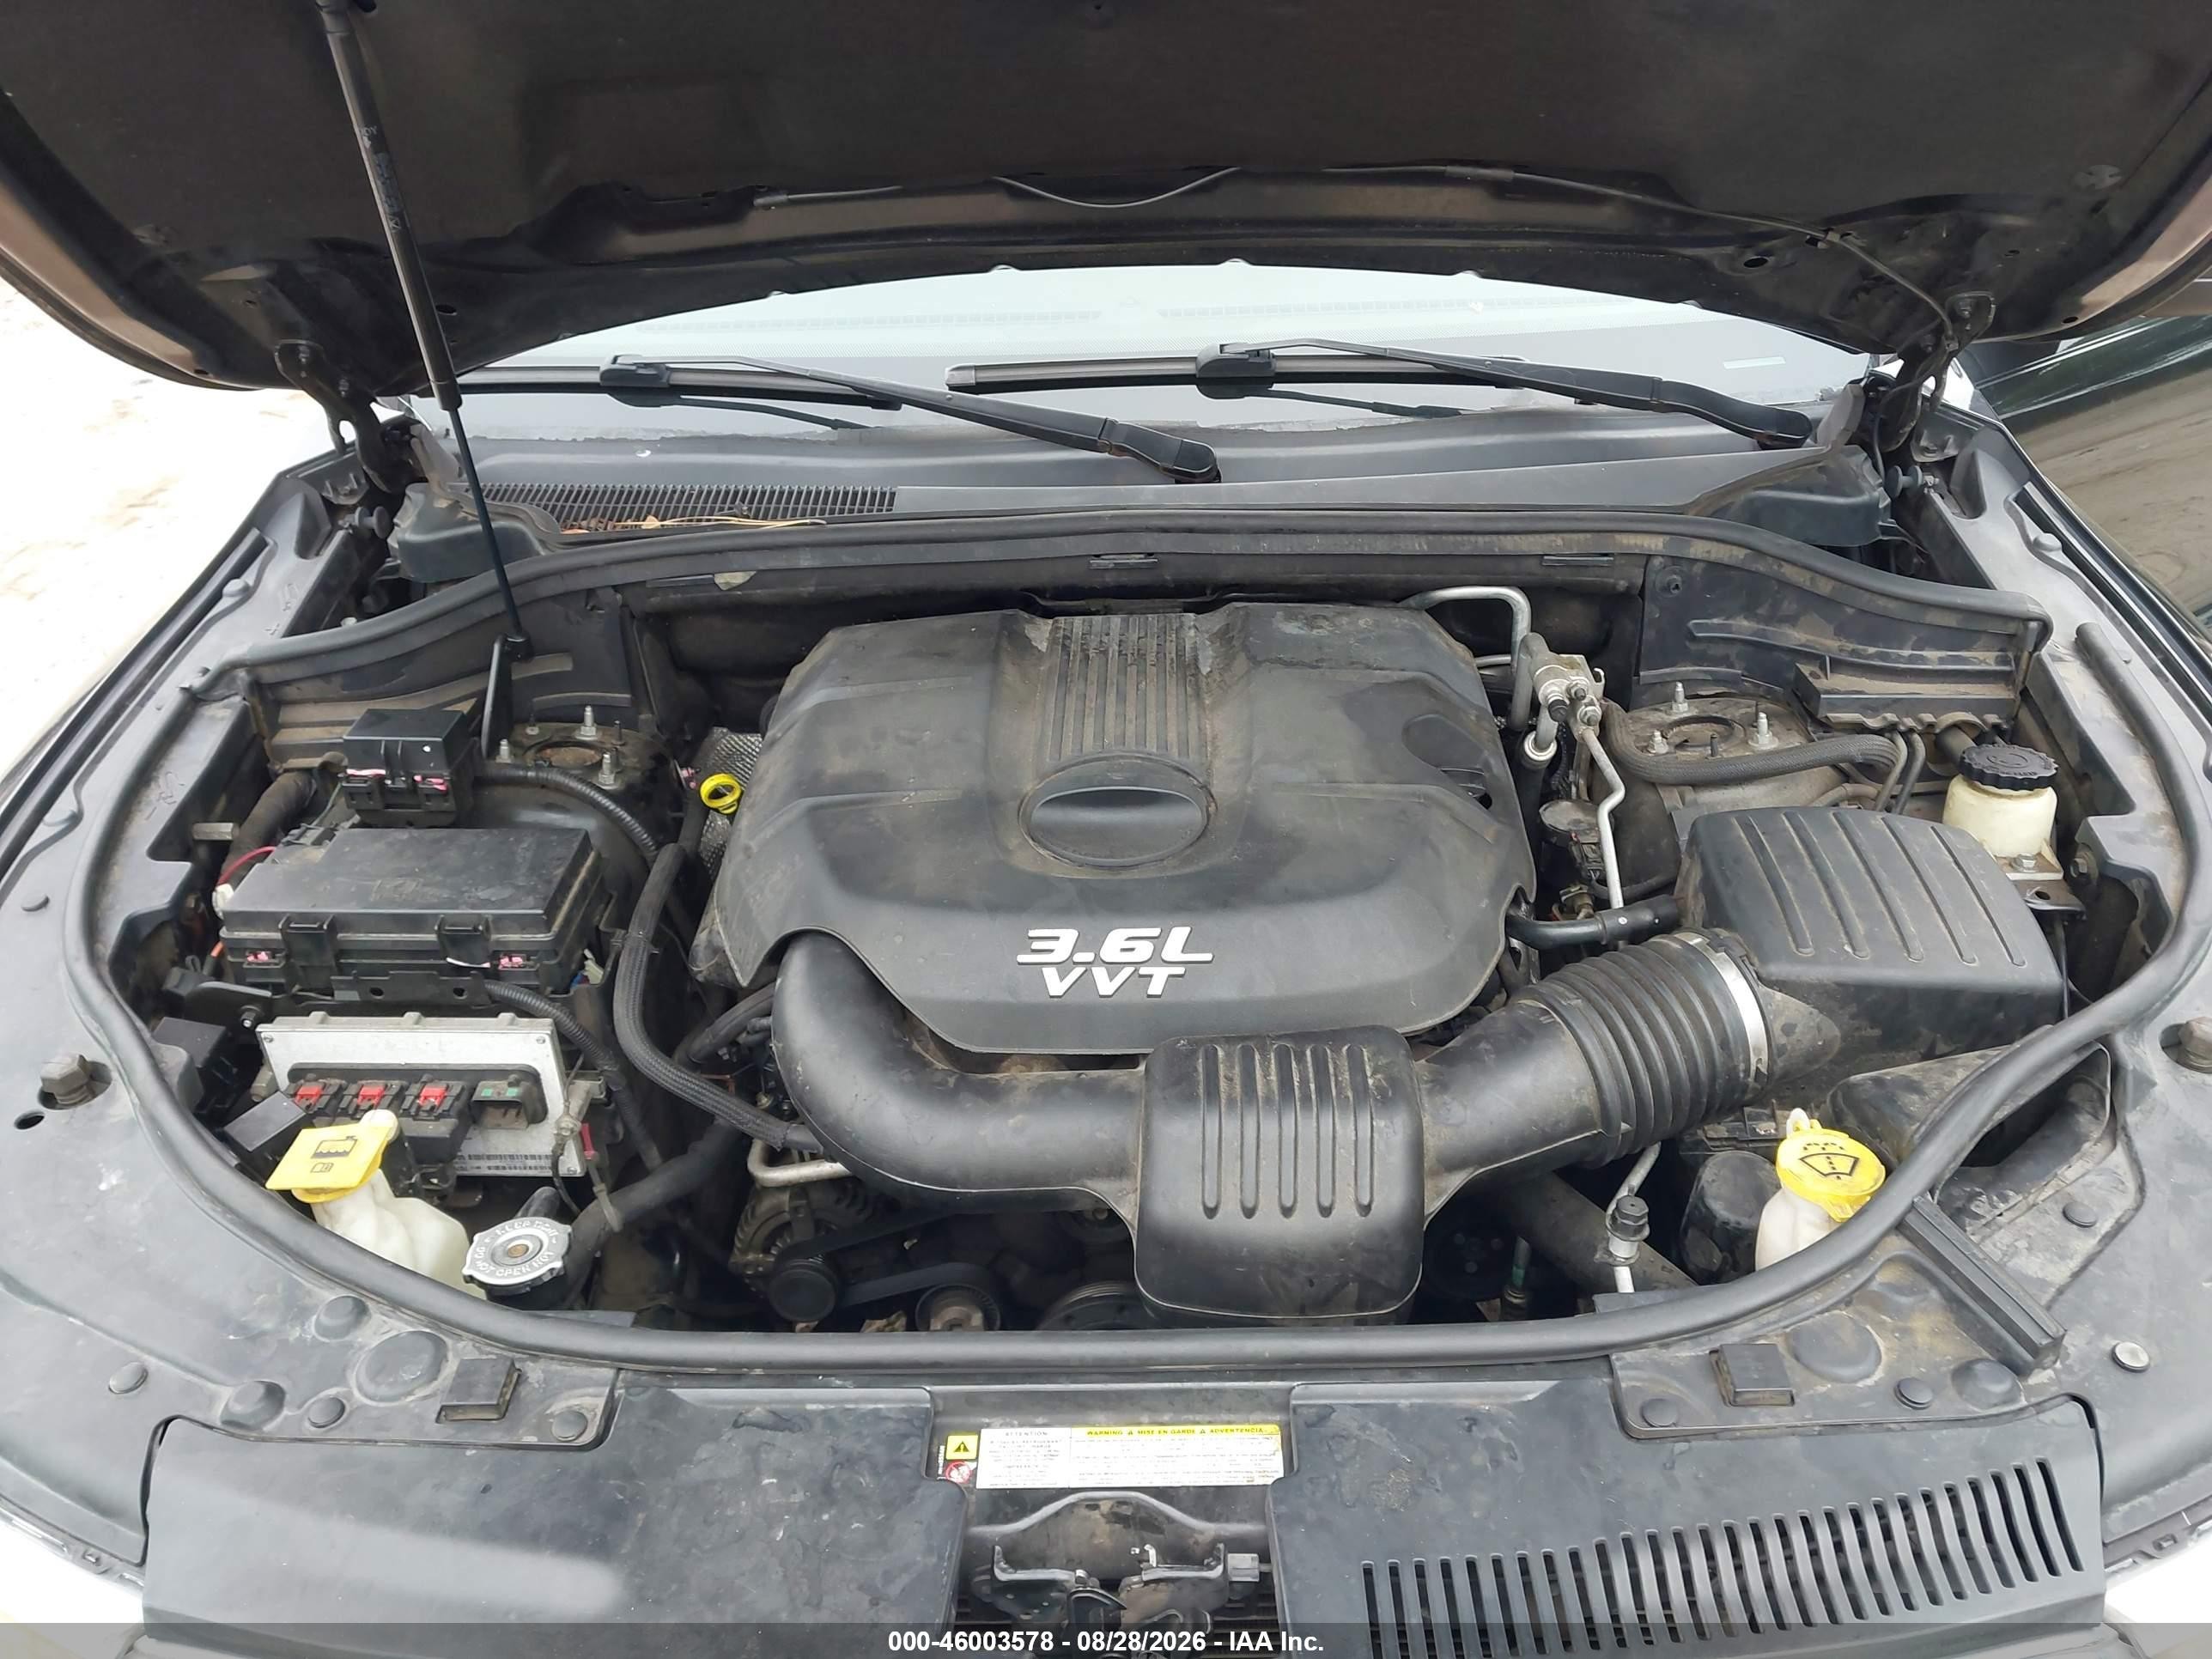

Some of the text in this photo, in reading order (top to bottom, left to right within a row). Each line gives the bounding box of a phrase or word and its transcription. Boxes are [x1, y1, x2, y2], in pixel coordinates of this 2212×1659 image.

[1017, 927, 1214, 965] 3.6L
[1042, 966, 1186, 998] VVT
[495, 1266, 532, 1278] OPEN
[532, 1251, 555, 1268] HOT
